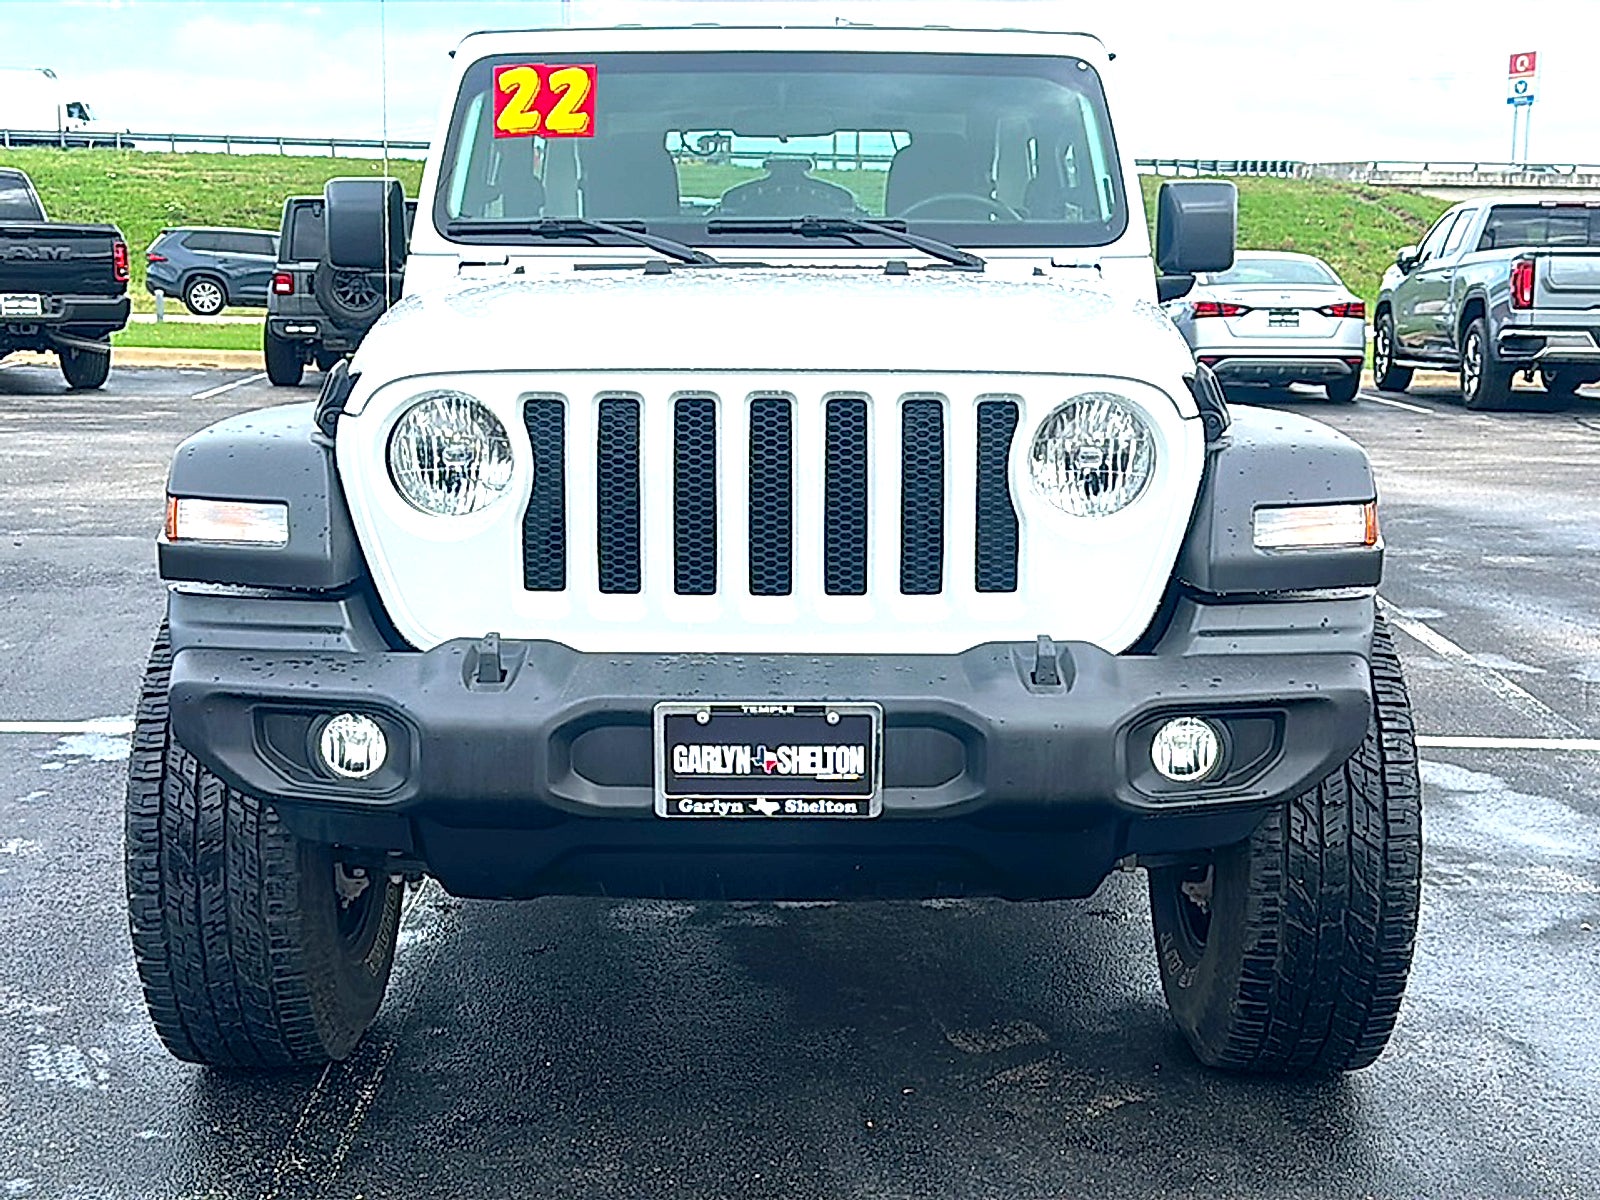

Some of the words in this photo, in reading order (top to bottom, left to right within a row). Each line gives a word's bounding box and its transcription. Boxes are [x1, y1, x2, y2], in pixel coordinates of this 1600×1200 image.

[496, 66, 591, 134] 22
[0, 246, 71, 261] AM
[741, 705, 795, 714] TEMPLE
[673, 744, 751, 775] GARLYN
[776, 745, 865, 775] SHELTON
[678, 798, 745, 816] Garlyn
[784, 799, 858, 814] Shelton
